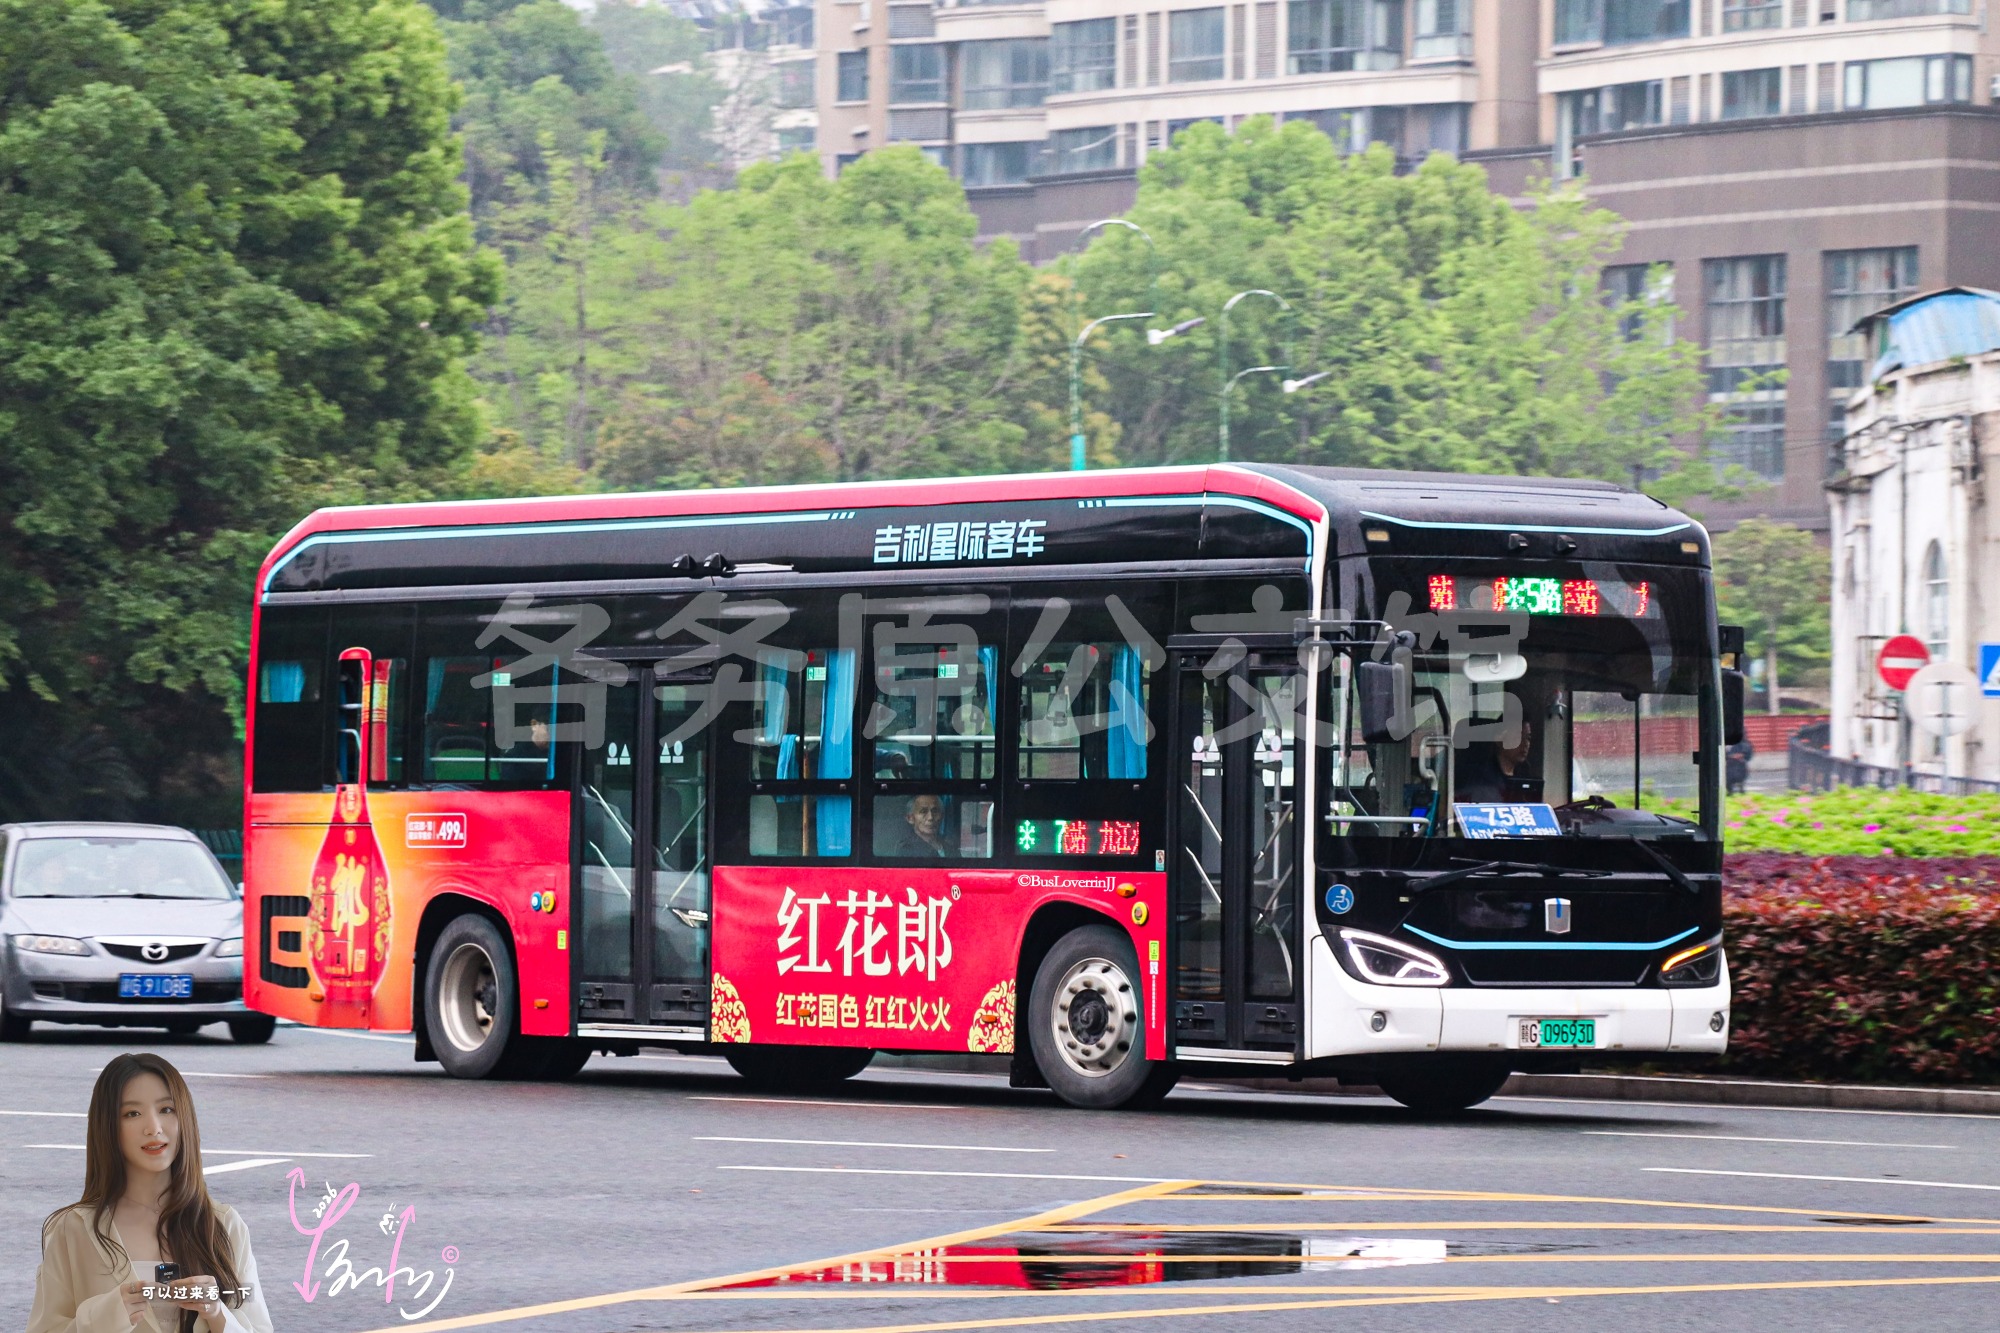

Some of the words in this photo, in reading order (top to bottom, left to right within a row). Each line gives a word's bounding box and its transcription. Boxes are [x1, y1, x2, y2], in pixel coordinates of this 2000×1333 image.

[873, 519, 1047, 564] 吉利星际客车
[436, 821, 464, 840] 499
[1480, 806, 1536, 826] 75路
[777, 886, 953, 981] 红花郎
[776, 992, 860, 1028] 红花国色
[865, 995, 951, 1032] 红红火火
